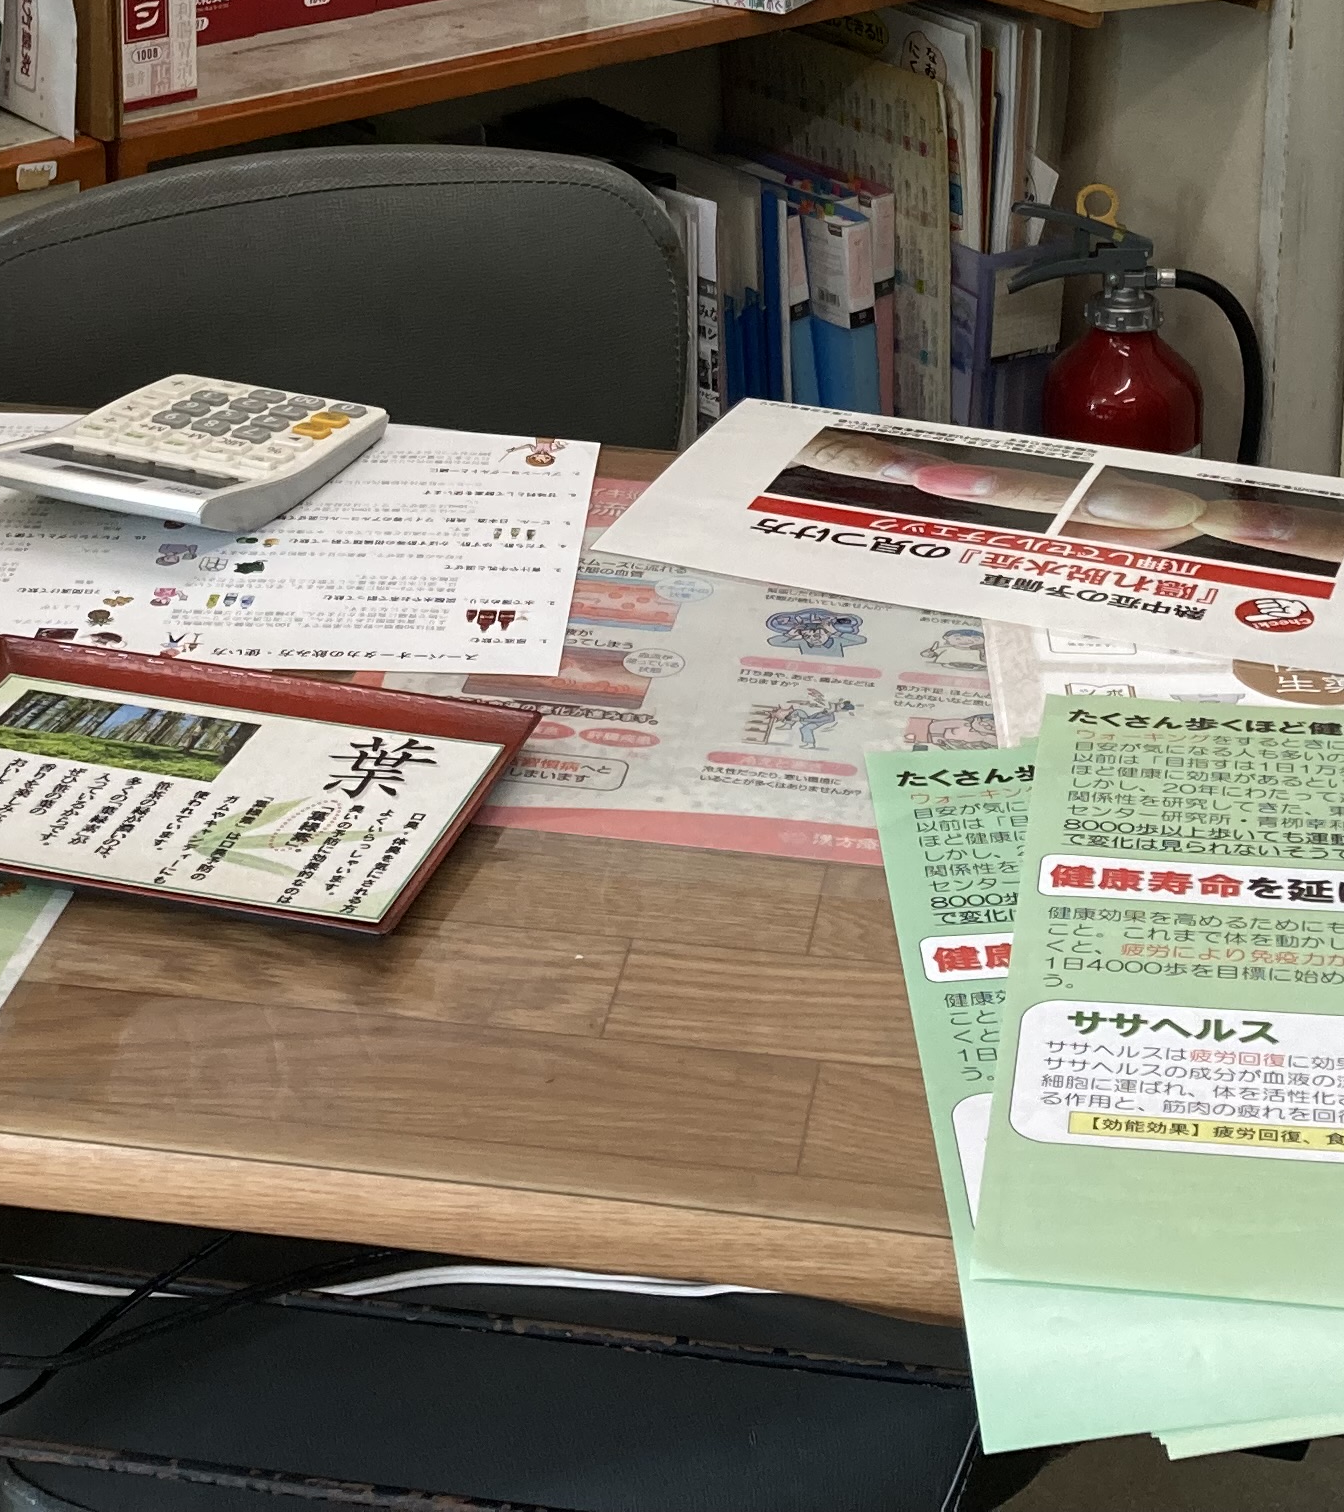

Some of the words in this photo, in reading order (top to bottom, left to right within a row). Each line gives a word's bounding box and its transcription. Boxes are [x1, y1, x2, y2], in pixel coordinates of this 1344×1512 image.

[136, 47, 158, 61] 1008
[322, 736, 440, 798] 葉
[1067, 1010, 1280, 1044] ササヘルス
